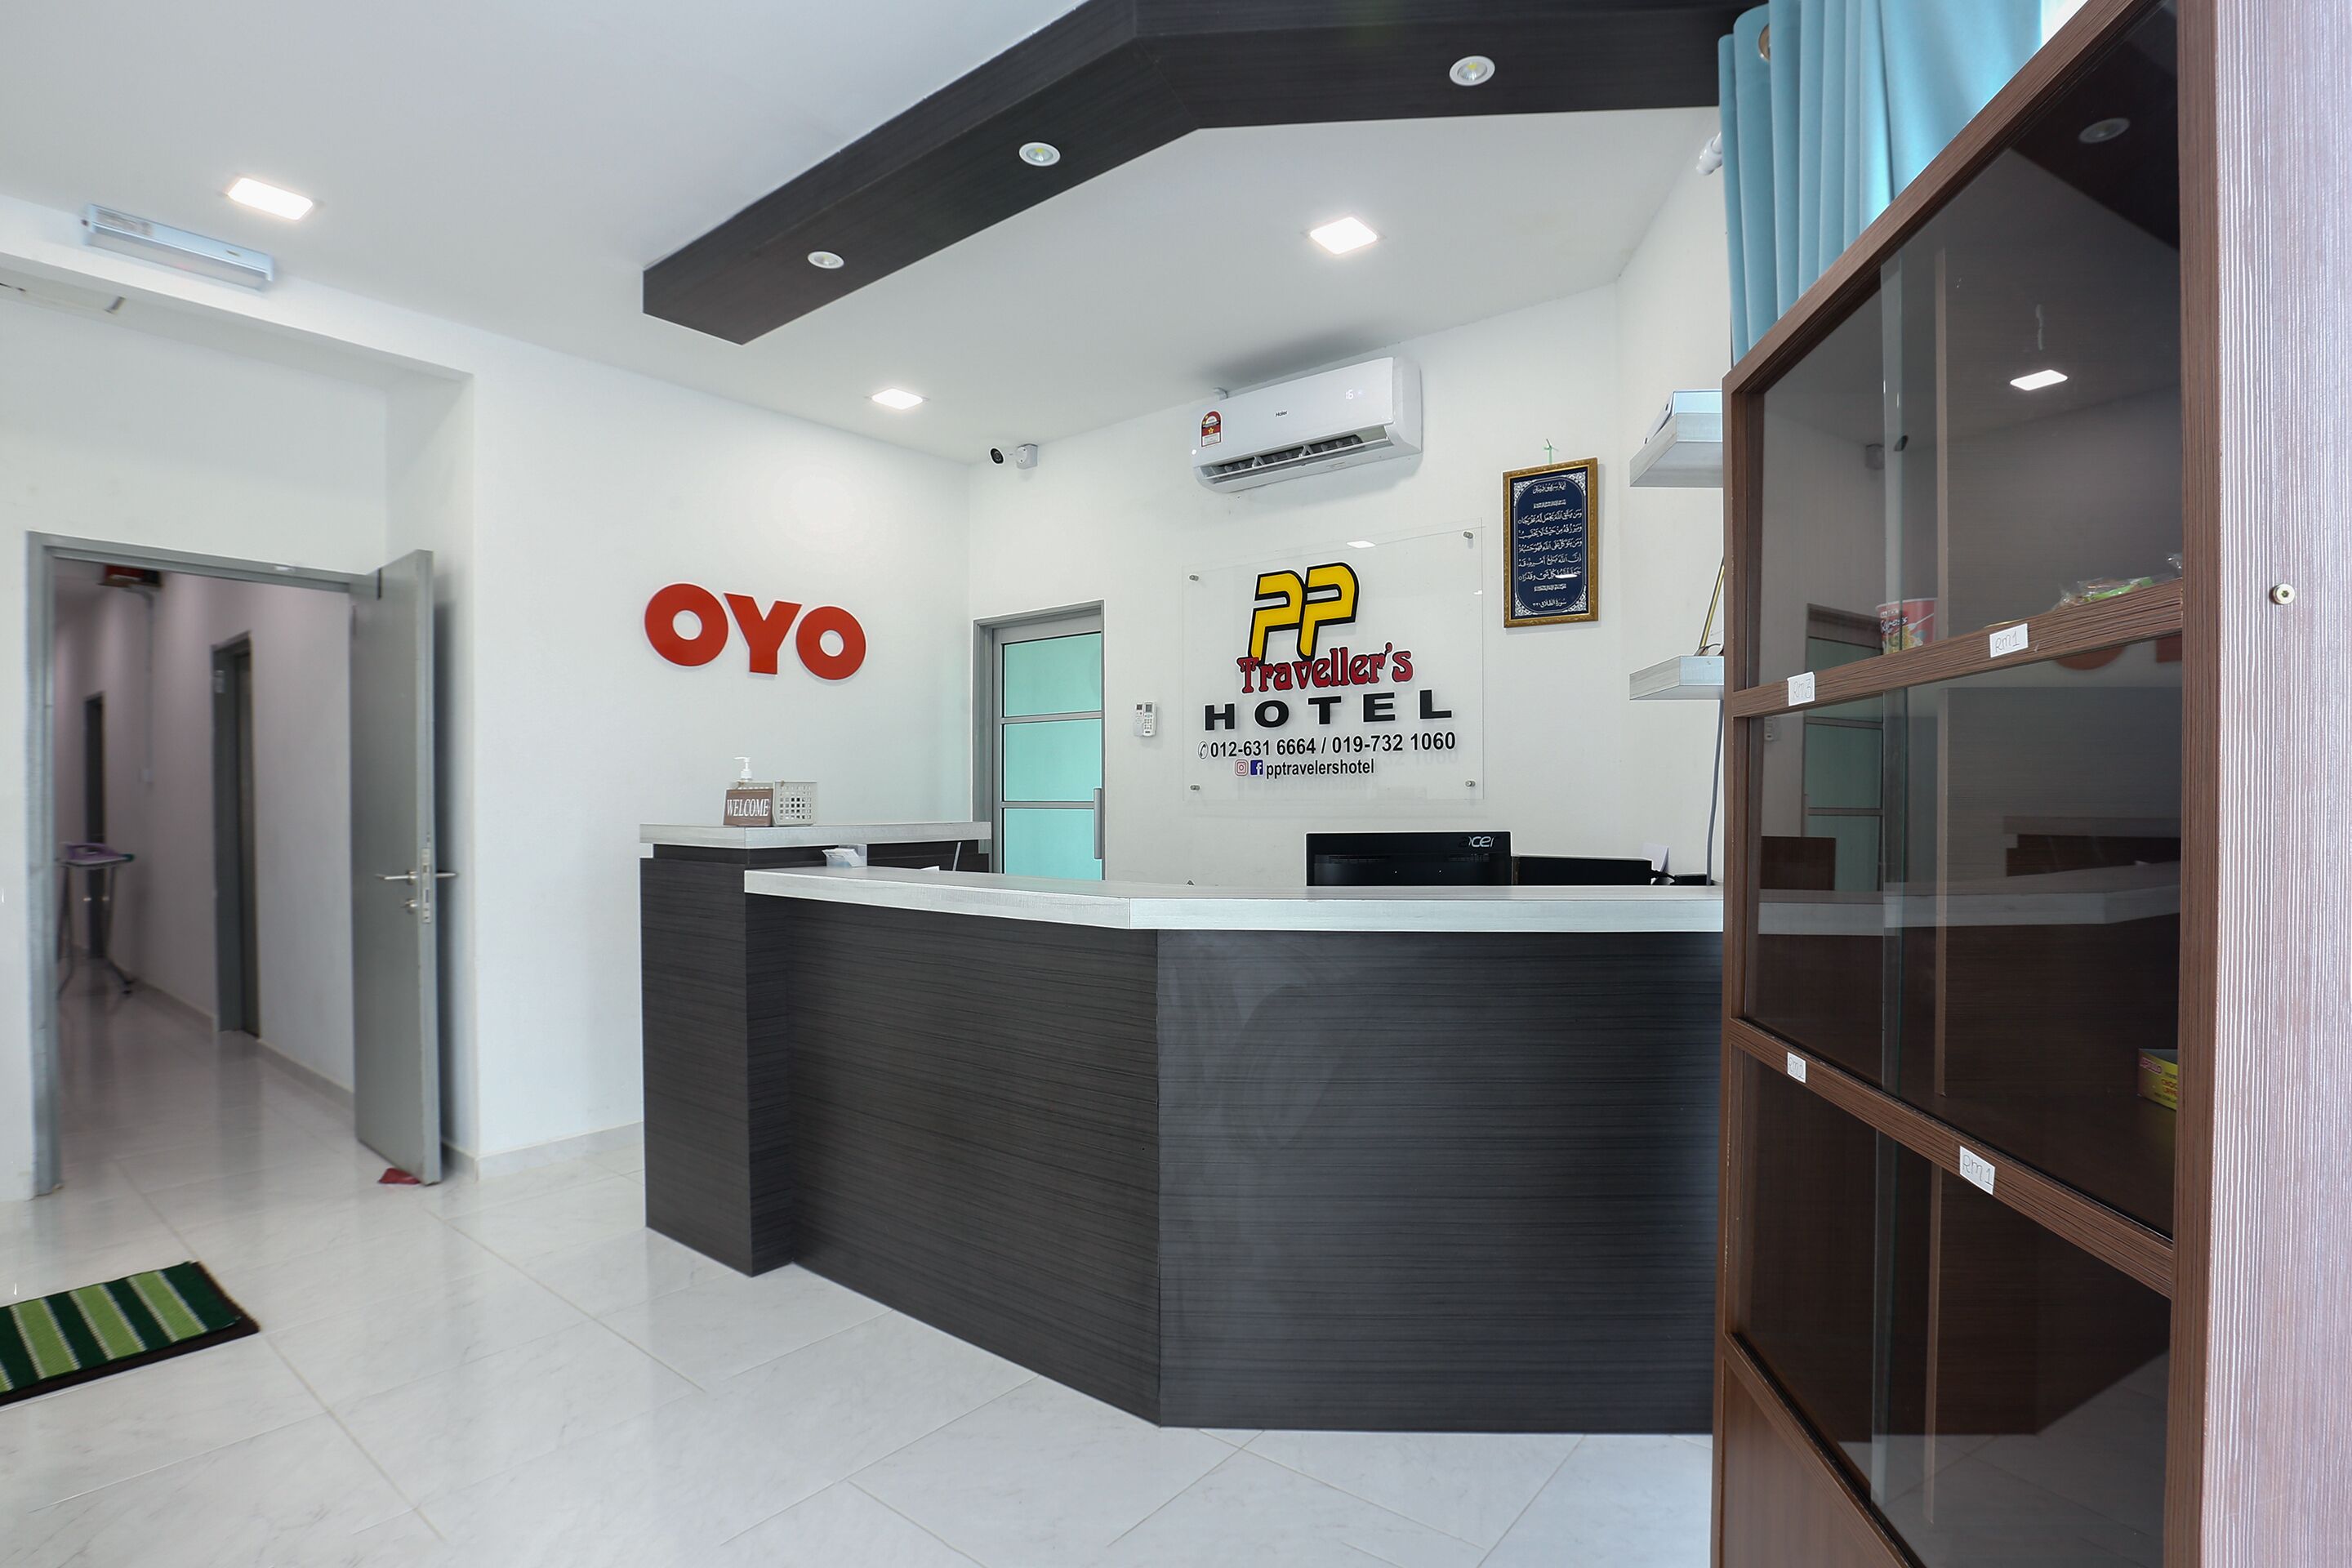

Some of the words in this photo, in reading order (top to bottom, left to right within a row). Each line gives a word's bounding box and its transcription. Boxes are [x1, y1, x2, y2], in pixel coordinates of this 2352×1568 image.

[644, 583, 866, 680] OYO
[1236, 642, 1413, 693] Traveller's
[1204, 689, 1452, 731] HOTEL
[1210, 740, 1270, 758] 012-631
[1276, 737, 1316, 755] 6664
[1332, 734, 1403, 754] 019-732
[1410, 732, 1456, 751] 1060
[1266, 758, 1374, 779] pptravelershotel
[726, 798, 769, 817] WELCOME
